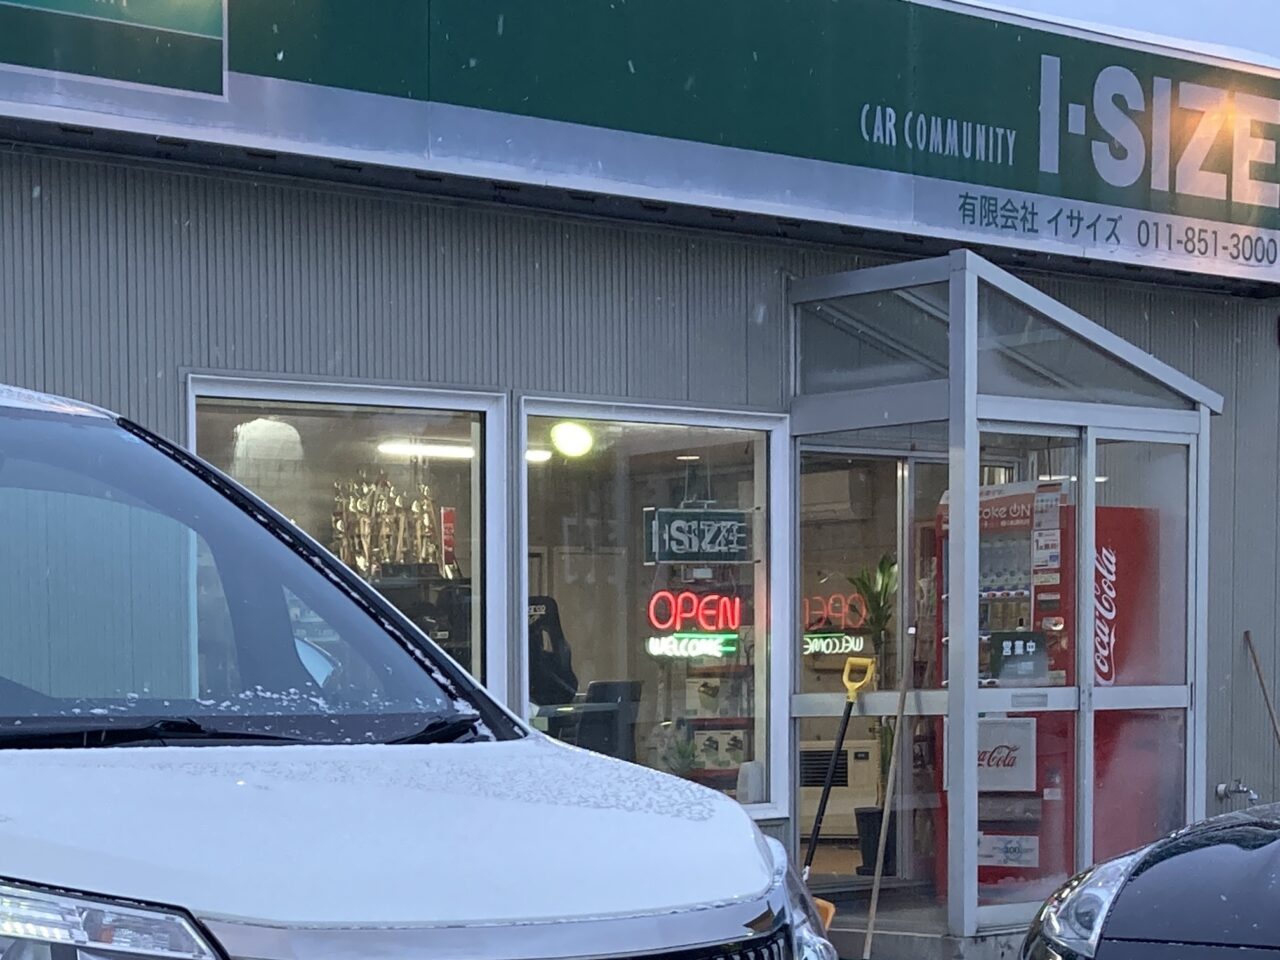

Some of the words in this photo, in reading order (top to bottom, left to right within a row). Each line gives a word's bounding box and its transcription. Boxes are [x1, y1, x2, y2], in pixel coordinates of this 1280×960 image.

[860, 103, 897, 146] CAR
[904, 111, 1017, 166] COMMUNITY
[1038, 54, 1280, 208] I-SIZE
[958, 192, 1039, 234] 有限会社
[1047, 207, 1123, 246] イサイズ
[1137, 219, 1278, 266] 011-851-3000
[978, 506, 1007, 519] oke
[648, 590, 740, 631] OPEN
[648, 634, 725, 658] WELCOME
